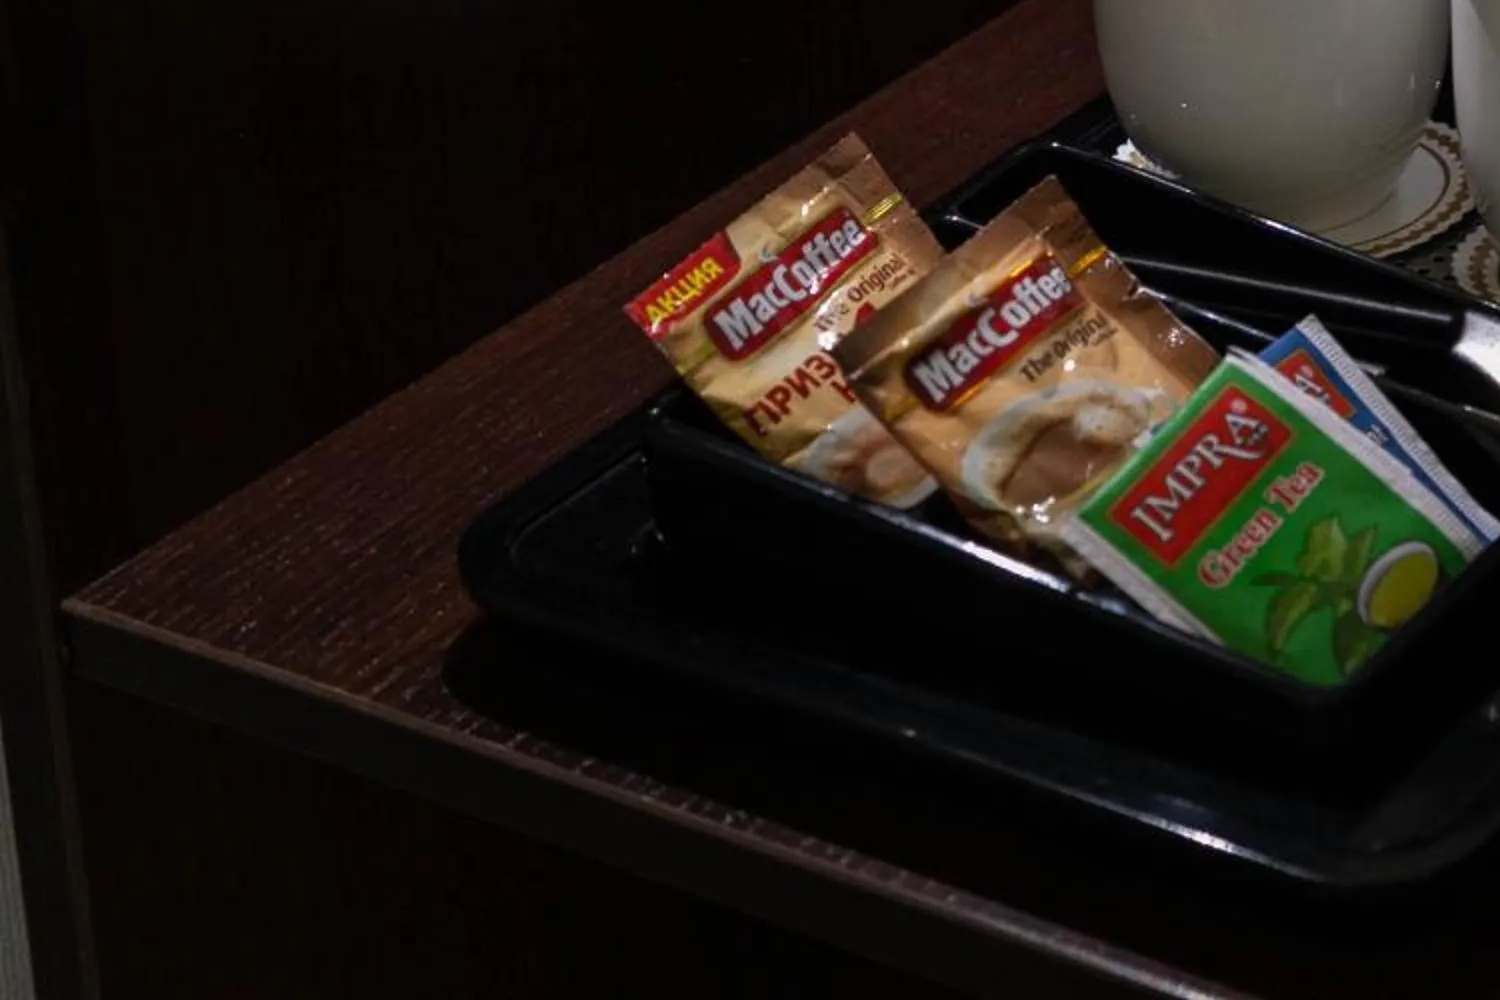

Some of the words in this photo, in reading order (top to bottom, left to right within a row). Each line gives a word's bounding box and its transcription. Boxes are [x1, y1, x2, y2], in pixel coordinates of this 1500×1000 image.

[644, 256, 724, 325] АКЦИЯ
[713, 219, 867, 351] MacCoffee
[1019, 351, 1054, 382] The
[1129, 408, 1270, 544] IMPRA
[1197, 508, 1284, 589] Green
[1264, 461, 1325, 514] Tea
